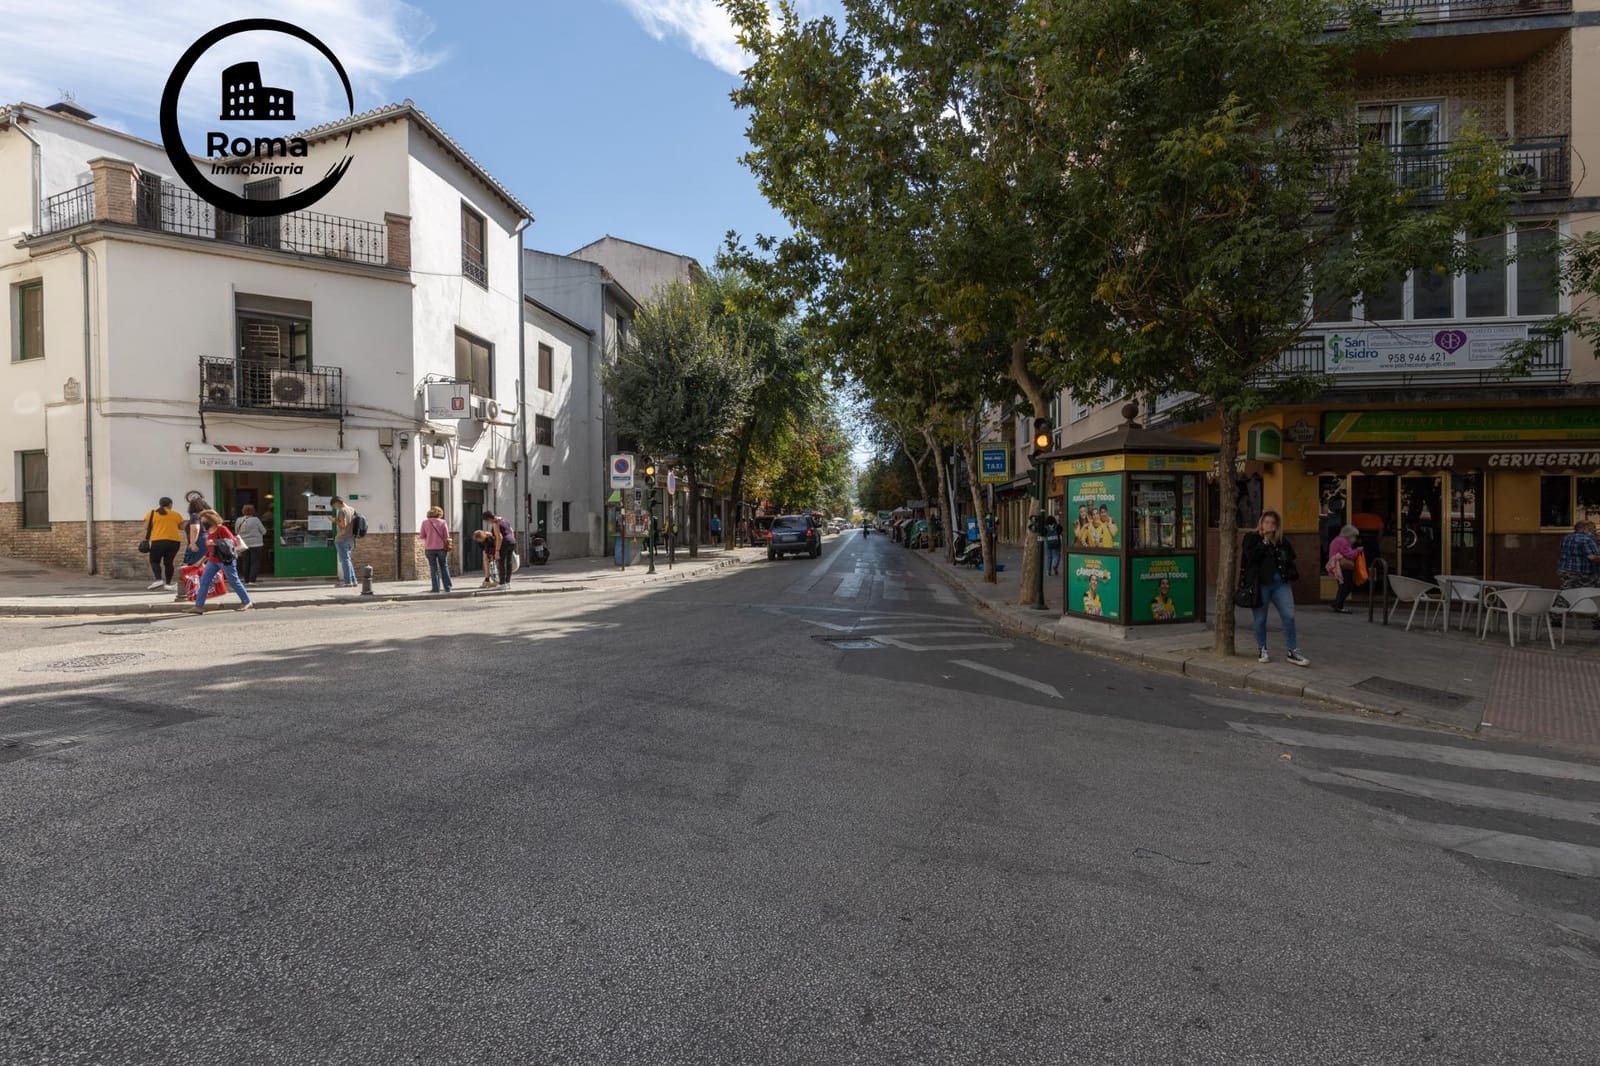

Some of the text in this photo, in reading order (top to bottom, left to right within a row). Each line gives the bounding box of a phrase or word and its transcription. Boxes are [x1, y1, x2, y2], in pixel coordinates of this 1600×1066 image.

[1344, 337, 1366, 348] San
[1344, 348, 1379, 359] Isidro
[1387, 352, 1446, 363] 958 946 421
[207, 460, 228, 468] gracia
[1360, 452, 1600, 468] CAFETERIA CERVECERIA
